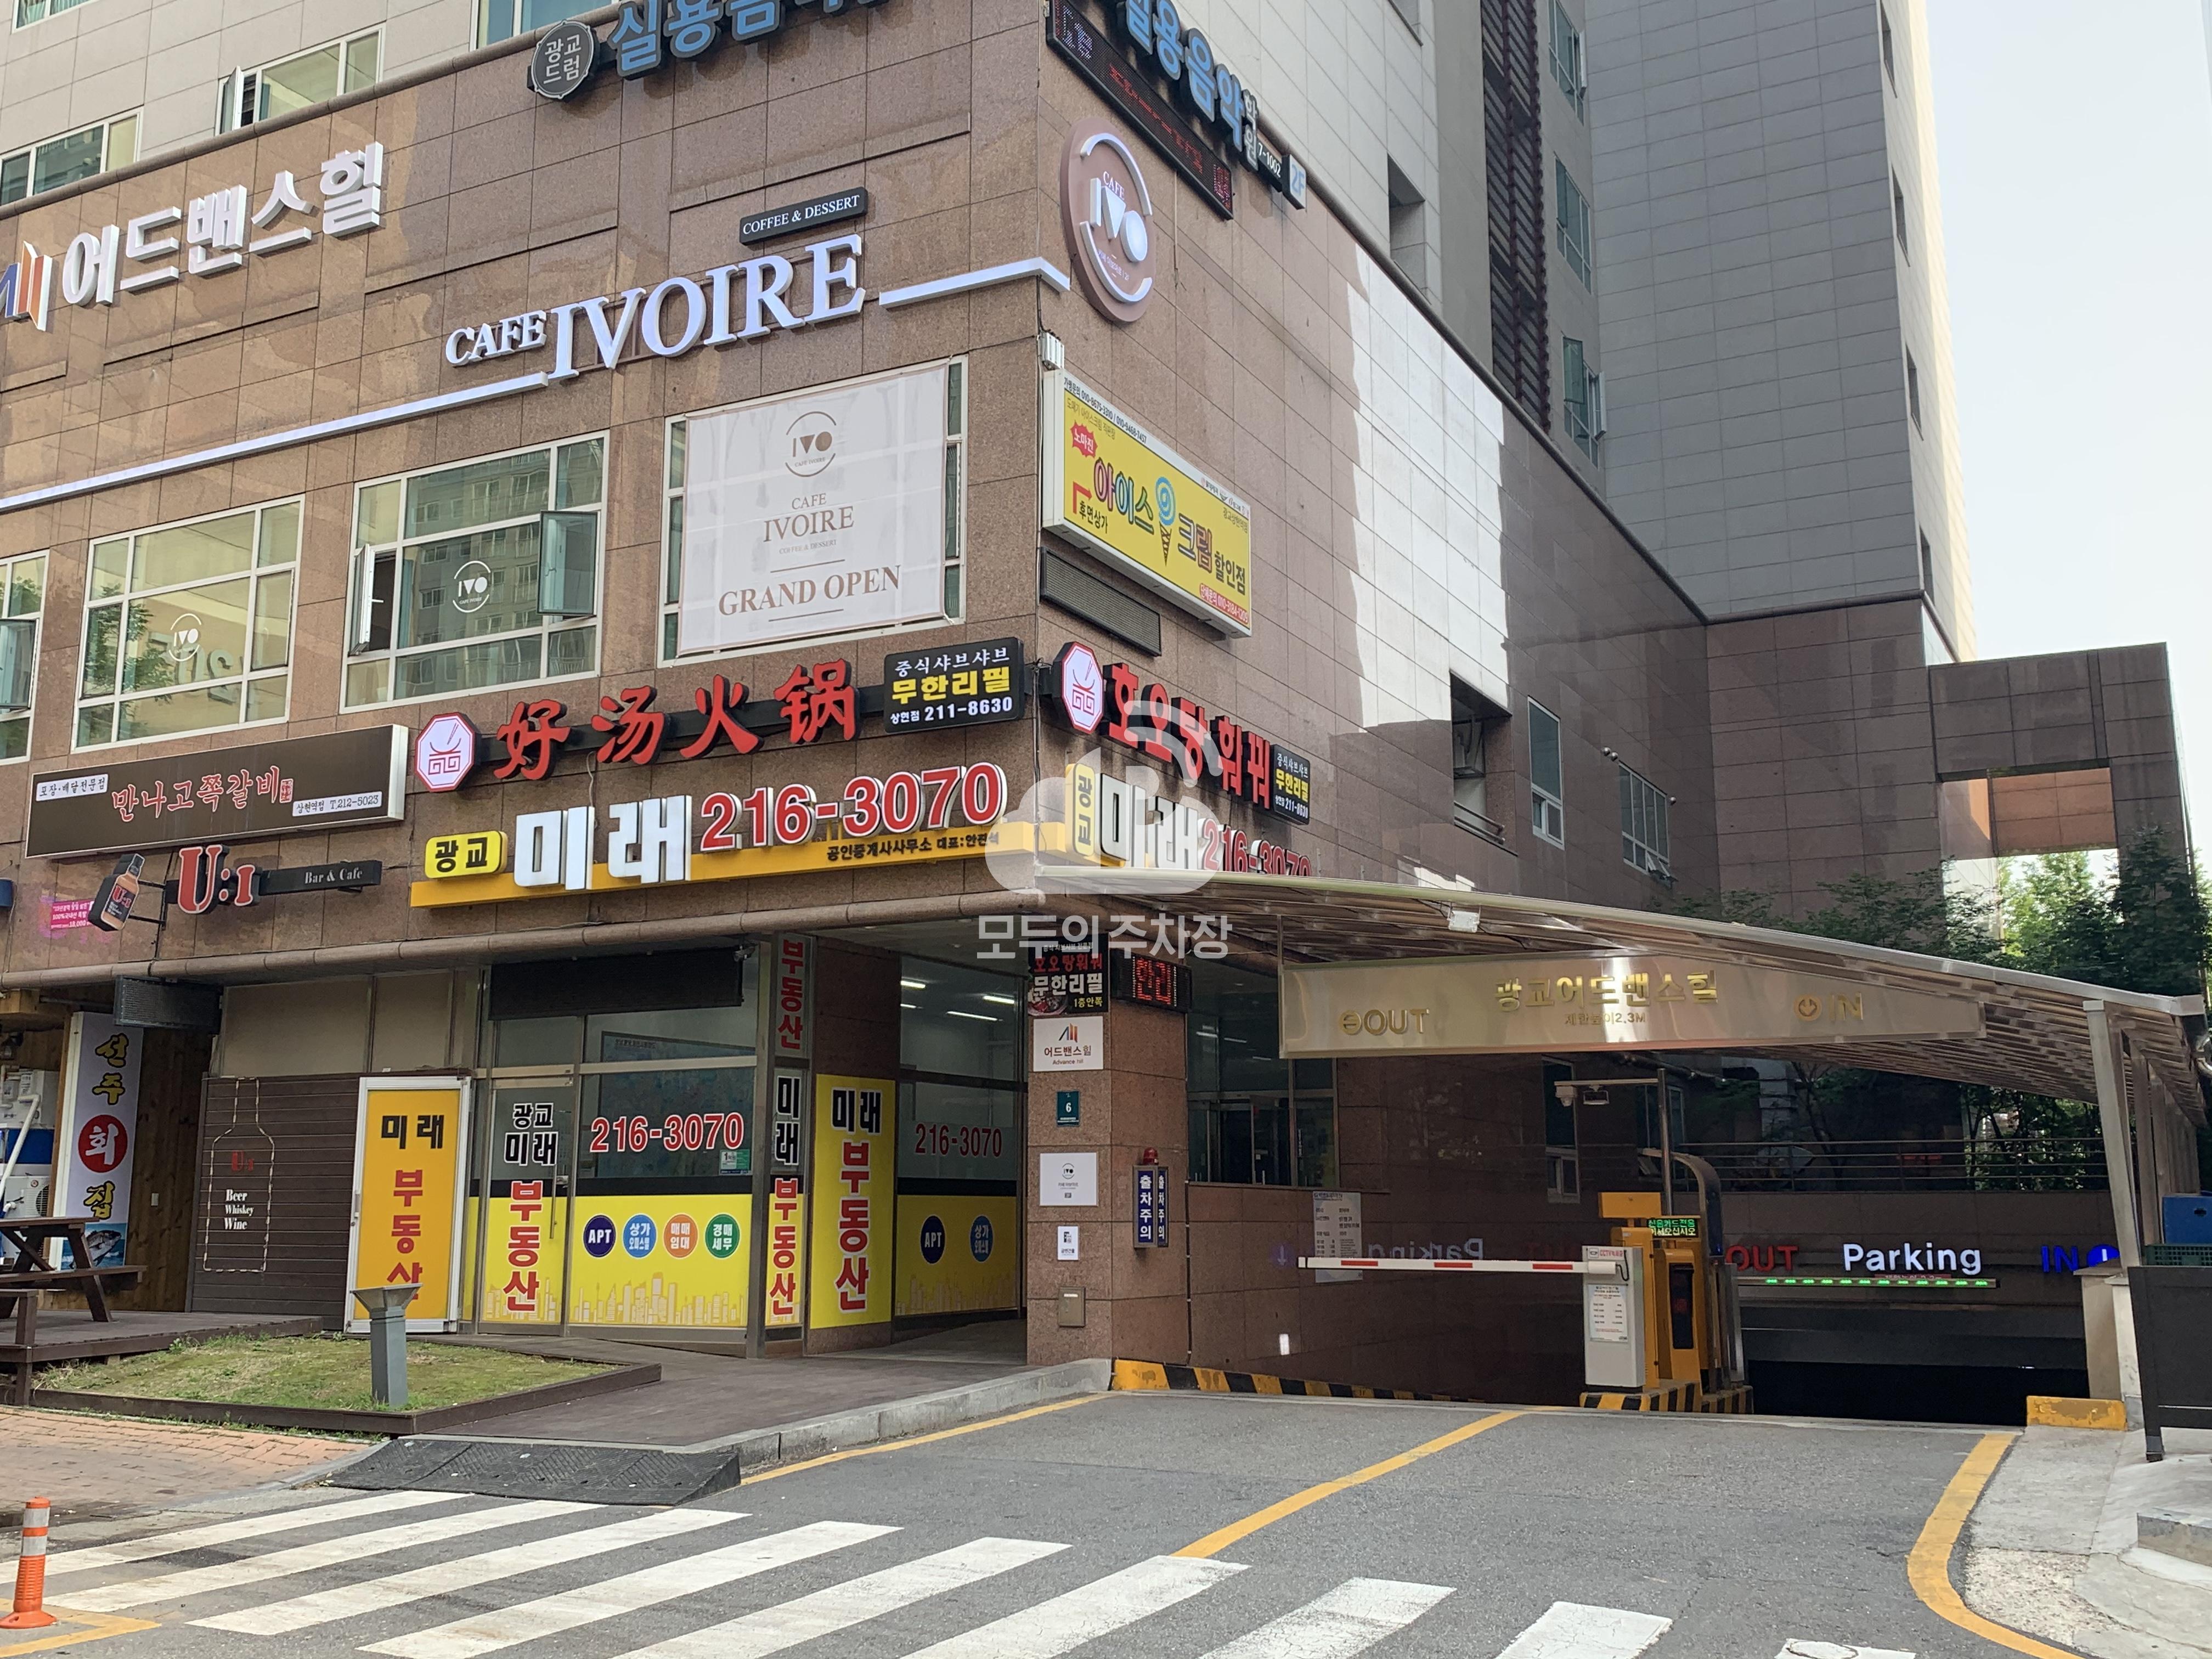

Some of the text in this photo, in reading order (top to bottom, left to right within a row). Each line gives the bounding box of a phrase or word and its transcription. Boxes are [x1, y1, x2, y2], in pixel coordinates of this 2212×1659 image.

[543, 34, 582, 64] 광교
[610, 0, 839, 75] 실용음
[543, 54, 581, 84] 드럼
[1244, 90, 1259, 170] 학원
[1103, 171, 1125, 200] CAFE
[1291, 164, 1305, 196] 2F
[62, 141, 383, 305] 어드밴스힐
[743, 194, 861, 236] COFFEE & DESSERT
[445, 234, 866, 380] CAFE IVOIRE
[1074, 428, 1094, 454] 노마진
[792, 493, 827, 510] CAFE
[763, 506, 855, 542] IVOIRE
[1079, 500, 1108, 534] 후면상가
[1094, 458, 1245, 596] 아이스 크림 할인점
[779, 544, 803, 555] COFFEE
[810, 539, 837, 550] DESSERT
[718, 565, 901, 616] GRAND OPEN
[894, 647, 1010, 678] 중식샤브샤브
[891, 665, 1011, 705] 무한리필
[494, 658, 857, 780] 好汤火锅
[890, 696, 1013, 725] 상현점 211-8630
[1109, 662, 1270, 809] 호오탕훠궈
[111, 765, 280, 822] 만나고쪽갈비
[1276, 768, 1308, 803] 무한리필
[296, 794, 379, 814] 상현역점 T.212-5023
[1285, 797, 1308, 819] 211-8630
[435, 762, 1007, 890] 광교 미래 216-3070
[1077, 774, 1092, 847] 광교
[1100, 774, 1199, 870] 미래
[827, 837, 932, 861] 공인중개사사무소
[304, 867, 363, 884] Bar & Cafe
[778, 939, 804, 1050] 부동산
[1034, 973, 1103, 996] 무한리필
[1826, 992, 1863, 1021] IN
[1364, 1008, 1430, 1036] OUT
[1044, 1045, 1092, 1057] 어드밴스힐
[513, 1102, 554, 1129] 광교
[831, 1087, 883, 1135] 미래
[1065, 1102, 1072, 1113] 6
[381, 1115, 444, 1149] 미래
[590, 1112, 744, 1153] 216-3070
[915, 1123, 1002, 1158] 216-3070
[504, 1132, 558, 1166] 미래
[225, 1189, 248, 1201] Beer
[769, 1075, 802, 1317] 미래 부동산
[1139, 1174, 1152, 1240] 출차주의
[224, 1217, 248, 1230] Wine
[225, 1204, 255, 1217] Whiskey
[387, 1169, 423, 1300] 부동산
[588, 1229, 612, 1244] APT
[630, 1223, 651, 1235] 상가
[670, 1223, 690, 1235] 매매
[713, 1224, 733, 1237] 경매
[834, 1139, 870, 1313] 부동산
[924, 1232, 942, 1248] APT
[974, 1224, 989, 1239] 상가
[503, 1181, 544, 1312] 부동산
[670, 1237, 690, 1250] 임대
[712, 1238, 732, 1250] 세무
[1725, 1245, 1799, 1272] OUT
[1842, 1242, 1983, 1276] Parking
[2040, 1245, 2079, 1273] IN
